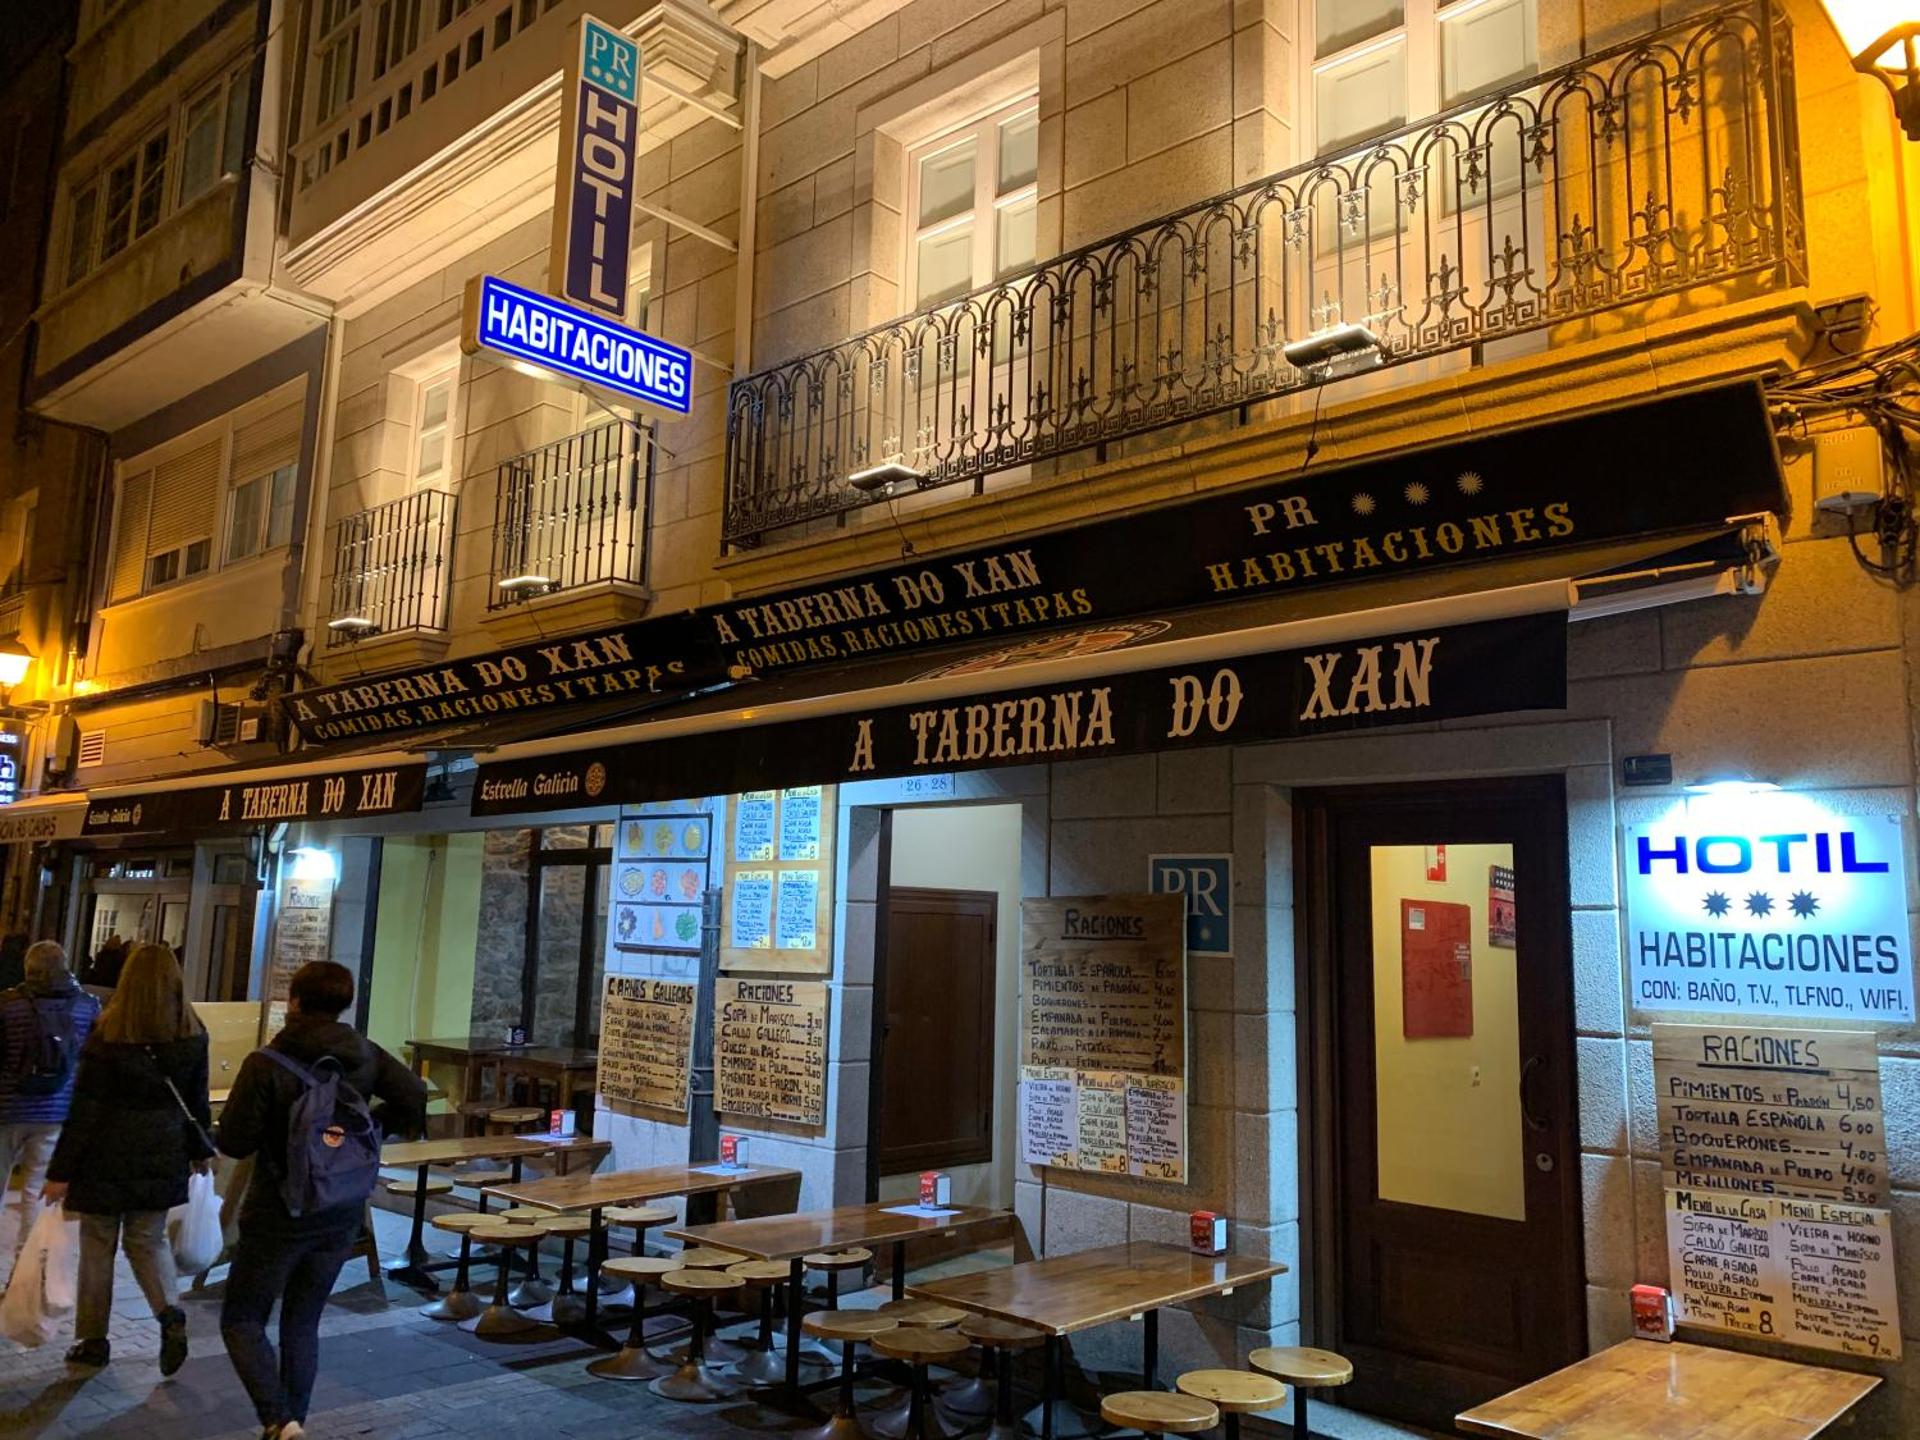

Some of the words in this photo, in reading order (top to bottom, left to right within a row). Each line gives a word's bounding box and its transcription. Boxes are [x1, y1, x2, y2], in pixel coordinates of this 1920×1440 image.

[589, 32, 631, 77] PR
[582, 90, 627, 308] HOTIL
[488, 295, 684, 397] HABITACIONES
[1244, 496, 1318, 535] PR
[1206, 502, 1574, 593] HABITACIONES
[712, 614, 739, 644] A
[737, 582, 891, 639] TABERNA
[891, 571, 944, 609] DO
[952, 550, 1042, 598] XAN
[296, 700, 318, 721] A
[318, 667, 469, 715] TABERNA
[473, 656, 527, 686] DO
[538, 632, 634, 675] XAN
[848, 720, 875, 772] A
[910, 688, 1115, 766] TABERNA
[1167, 668, 1244, 738] DO
[1300, 637, 1440, 721] XAN
[219, 790, 229, 821] A
[242, 782, 308, 820] TABERNA
[321, 777, 345, 813] DO
[357, 772, 398, 810] XAN
[481, 778, 528, 800] Estrella
[534, 771, 579, 795] Galicia
[907, 779, 921, 791] 26
[1637, 832, 1889, 874] HOTIL
[1639, 931, 1899, 975] HABITACIONES
[738, 982, 793, 1002] RACIONES
[1641, 980, 1680, 1000] CON:
[1688, 979, 1741, 1005] BAÑO,
[1747, 984, 1778, 1007] T.V.,
[1785, 985, 1853, 1011] TLFNO.,
[1860, 988, 1908, 1011] WIFI.
[1747, 1109, 1824, 1131] ESPAÑOLA
[1674, 1150, 1764, 1175] EMPANADA
[1784, 1160, 1832, 1181] PULPO
[1676, 1191, 1712, 1212] MENÚ
[1741, 1199, 1766, 1219] CASA
[1683, 1216, 1714, 1233] SOPA
[1781, 1202, 1814, 1218] MENÚ
